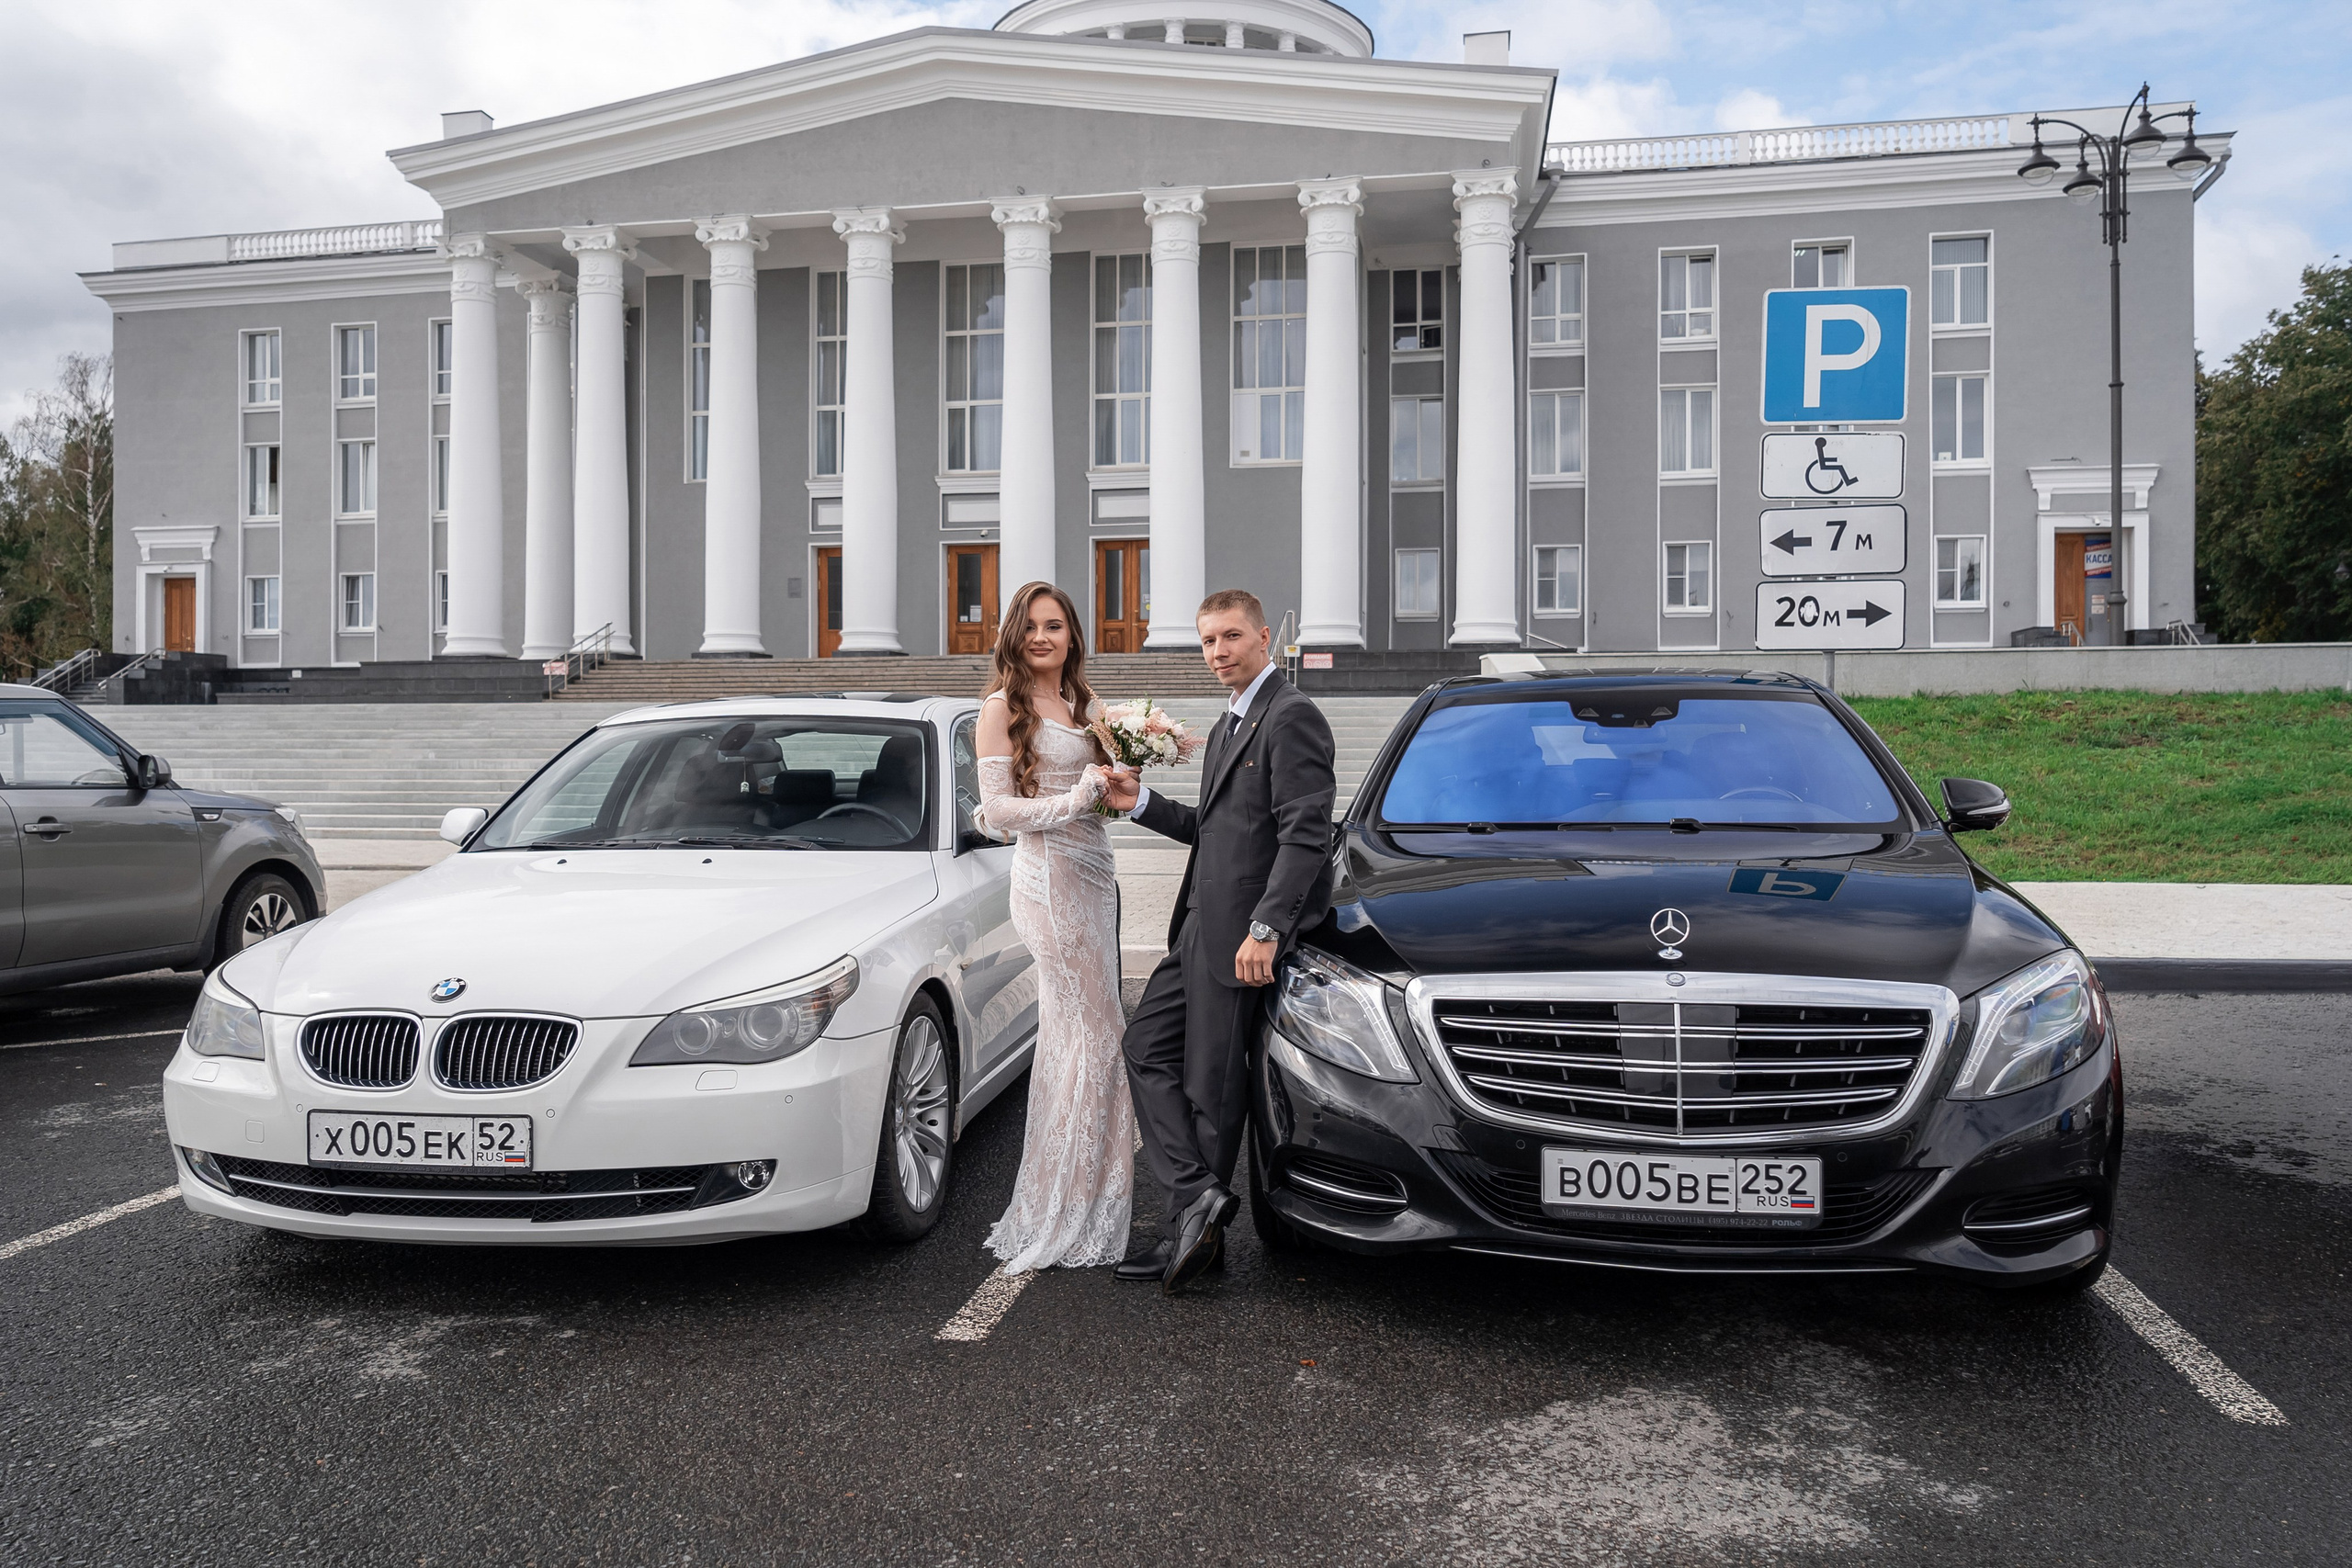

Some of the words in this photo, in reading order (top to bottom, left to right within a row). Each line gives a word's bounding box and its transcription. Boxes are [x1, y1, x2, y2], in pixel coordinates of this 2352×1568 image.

[1803, 304, 1882, 408] P
[2086, 554, 2112, 564] КАССА
[478, 1122, 515, 1150] 52
[476, 1151, 503, 1162] RUS
[1741, 1163, 1807, 1195] 252
[1757, 1195, 1789, 1207] RUS
[1561, 1208, 1596, 1218] Mercedes
[1598, 1211, 1616, 1219] Benz
[1620, 1213, 1654, 1222] ЗВЕЗДА
[1656, 1214, 1704, 1224] СТОЛИЦЫ
[1730, 1217, 1768, 1226] 974-22-22
[1771, 1219, 1803, 1227] РОЛЬФ
